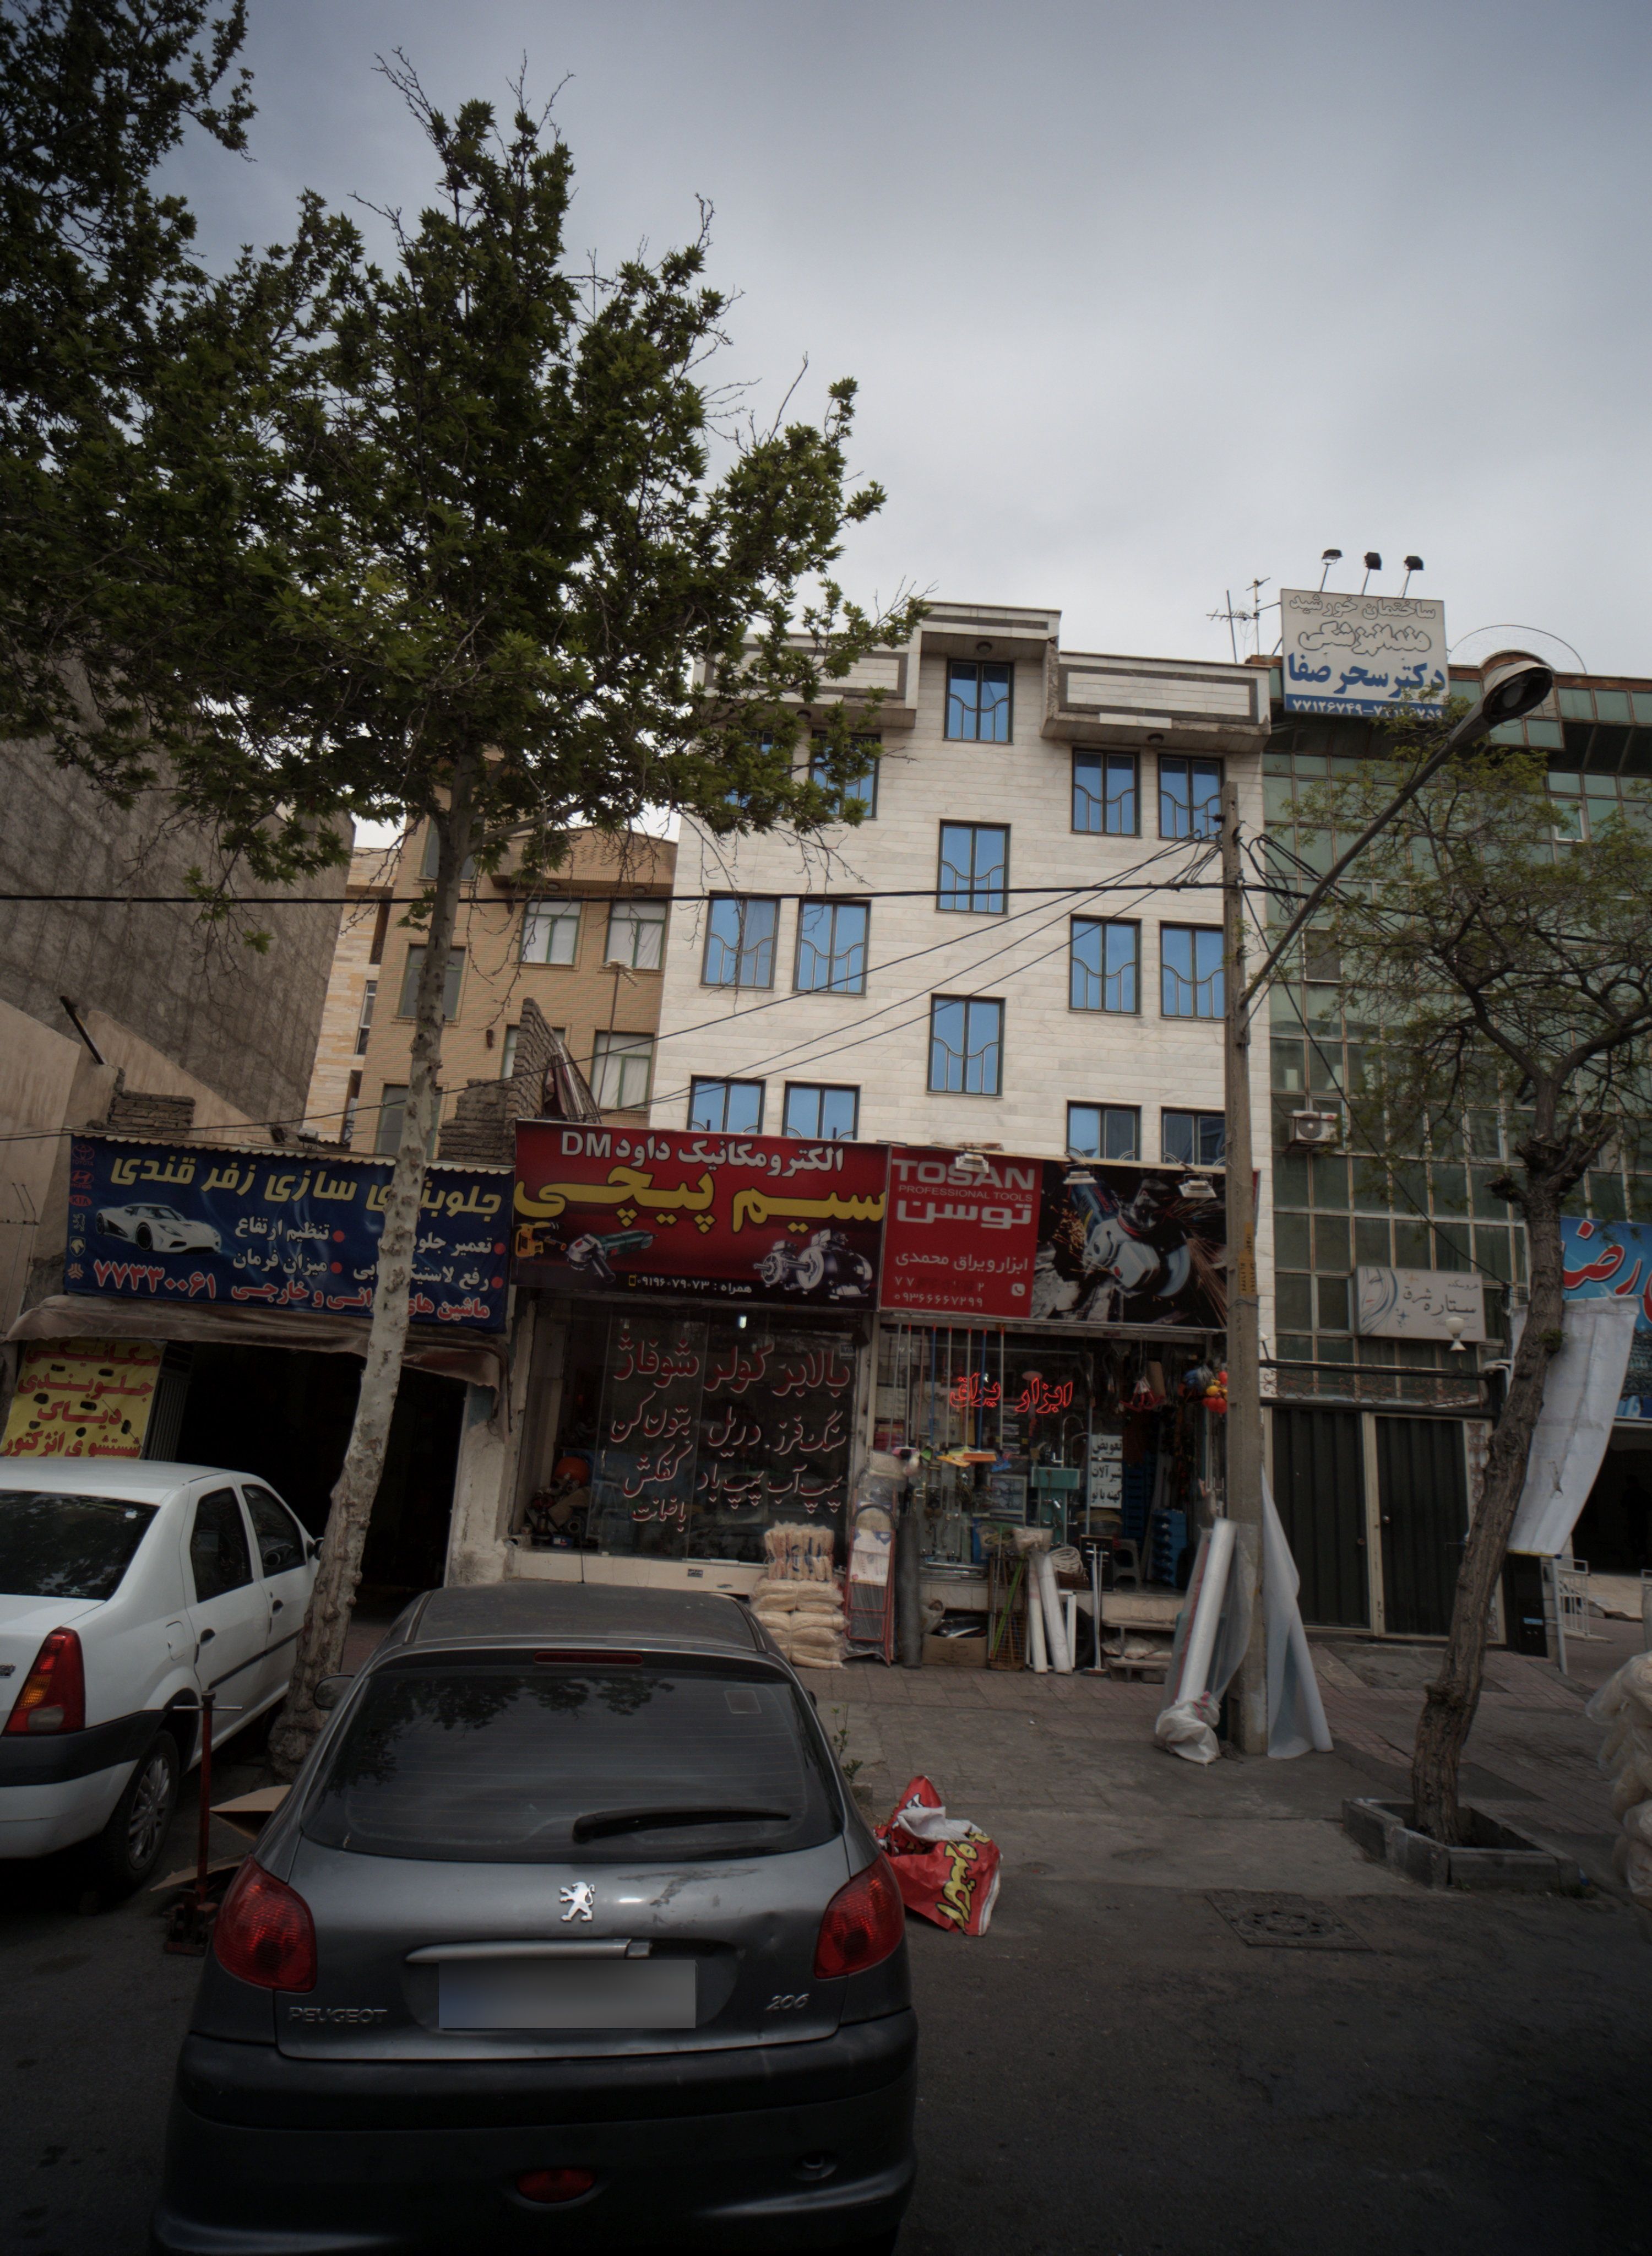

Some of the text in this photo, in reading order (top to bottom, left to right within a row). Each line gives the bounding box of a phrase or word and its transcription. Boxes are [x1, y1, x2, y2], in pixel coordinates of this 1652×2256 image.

[1288, 652, 1446, 698] دکتر سحر صفا
[561, 1131, 611, 1158] DM
[264, 1169, 358, 1203] سازی
[892, 1159, 1035, 1190] TOSAN
[513, 1165, 886, 1234] سیم پیچی
[898, 1185, 1033, 1202] PROFESSIONAL TOOLS
[897, 1200, 1032, 1229] توسن
[286, 1221, 330, 1243] تنظیم
[450, 1237, 493, 1257] تعمیر
[895, 1252, 949, 1266] محمدی
[232, 1248, 328, 1277] میزان فرمان
[93, 1259, 216, 1299] ۷۷۳۳۰۰۶۱
[231, 1280, 309, 1305] خارجی
[459, 1267, 490, 1291] رفع
[437, 1297, 491, 1321] ماشین
[18, 1373, 154, 1402] جلوبندی
[1014, 1376, 1073, 1414] ابزار
[288, 2006, 389, 2024] PEUGEOT
[764, 1993, 811, 2013] 206
